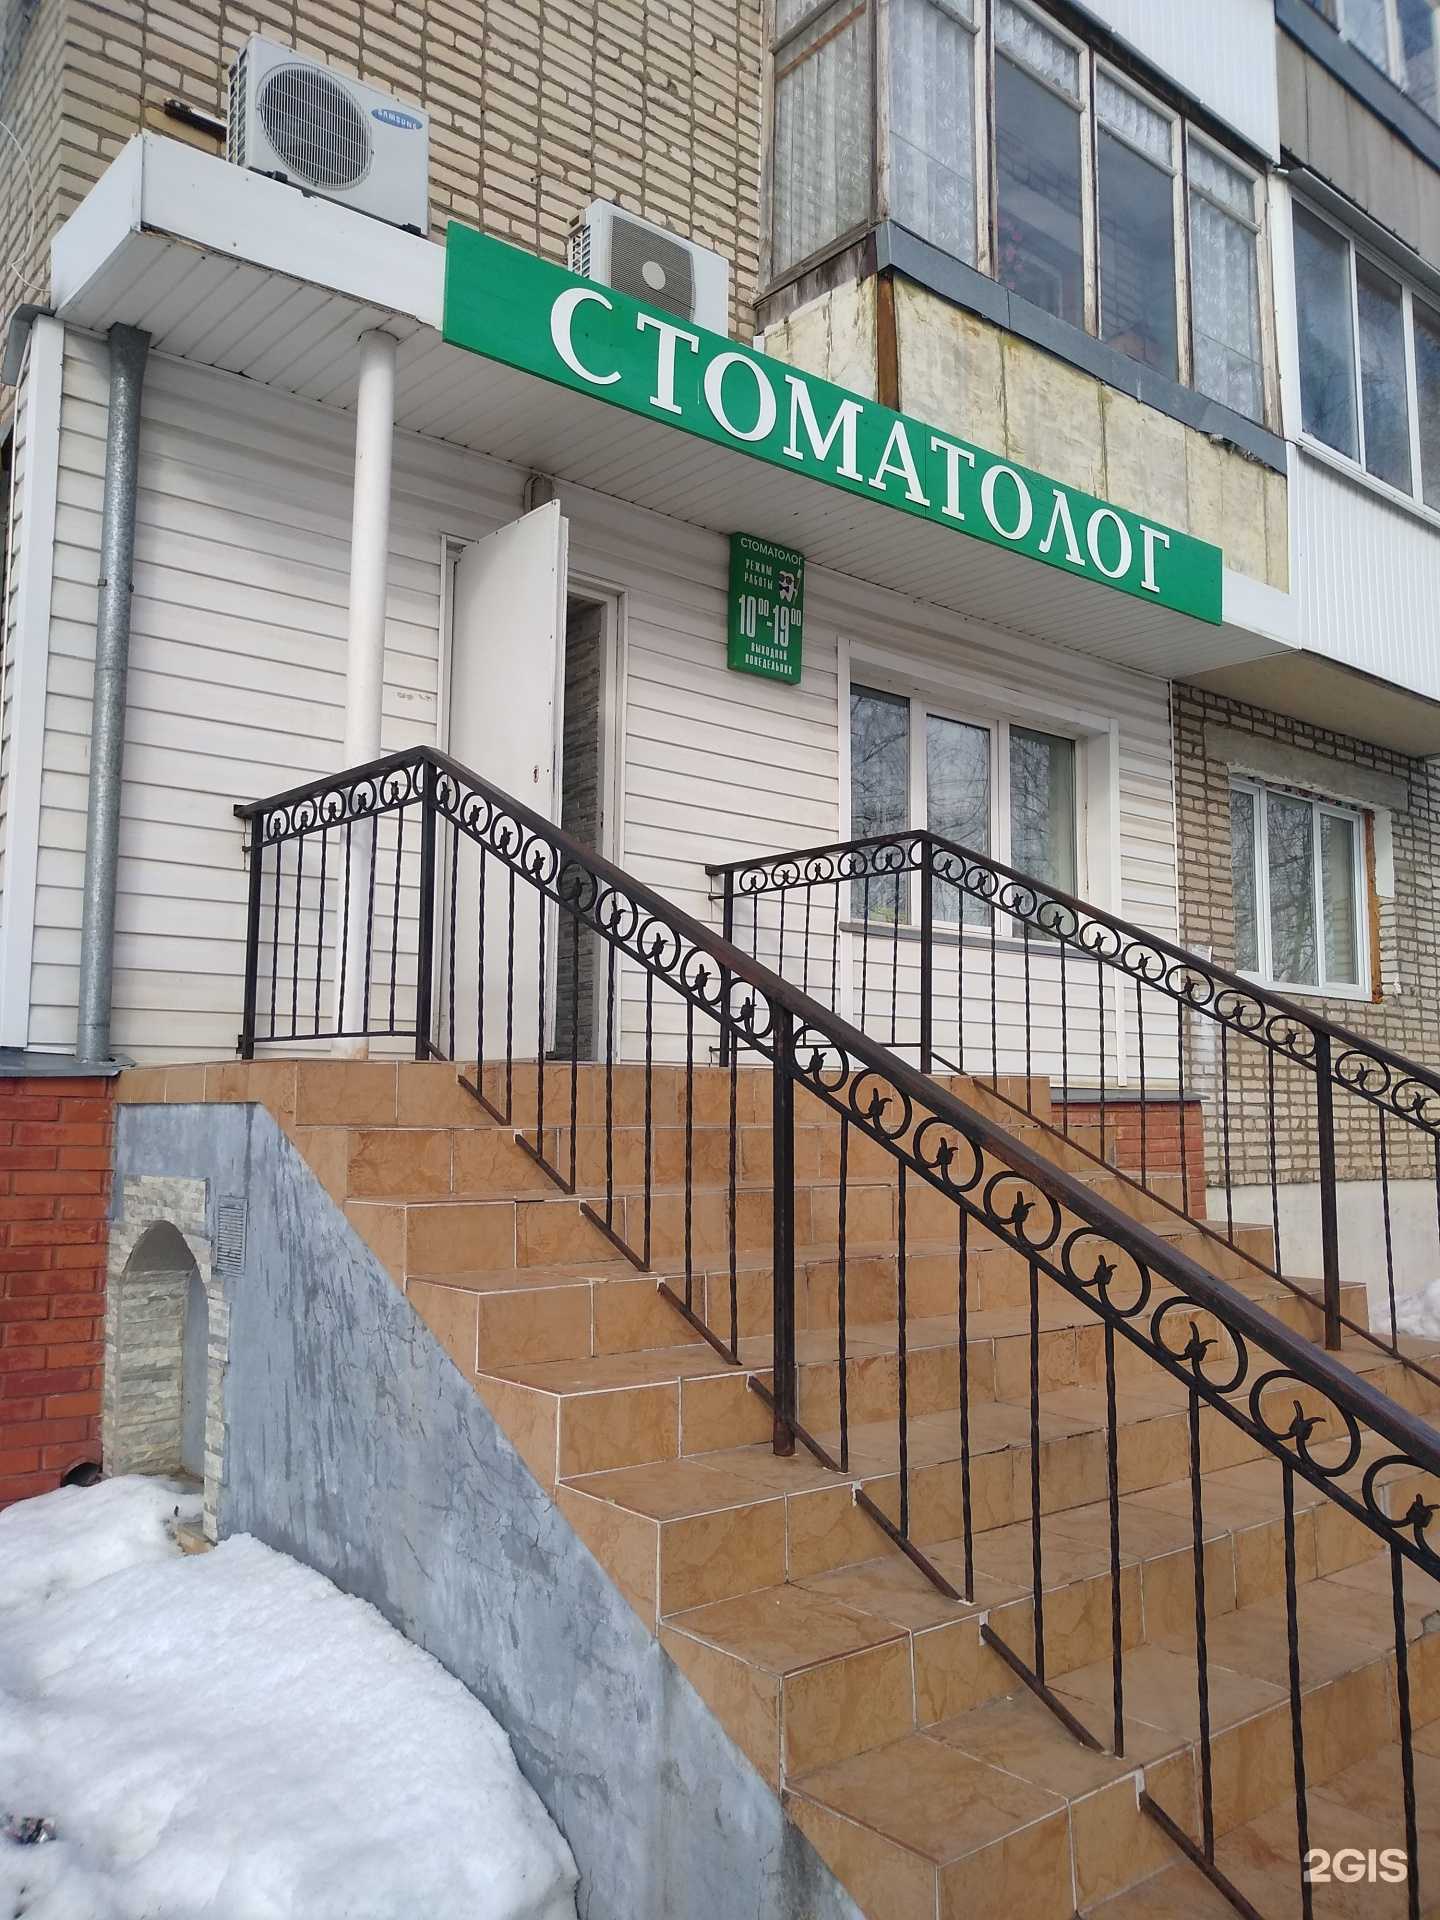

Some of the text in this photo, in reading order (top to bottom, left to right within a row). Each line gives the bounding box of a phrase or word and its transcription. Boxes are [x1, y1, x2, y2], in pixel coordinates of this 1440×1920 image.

[376, 109, 419, 129] SAMSUNG
[549, 287, 1171, 595] СТОМАТОЛОГ
[740, 537, 803, 566] СТОМАТОЛОГ
[745, 559, 773, 576] РЕЖИМ
[744, 571, 773, 591] РАБОТЫ
